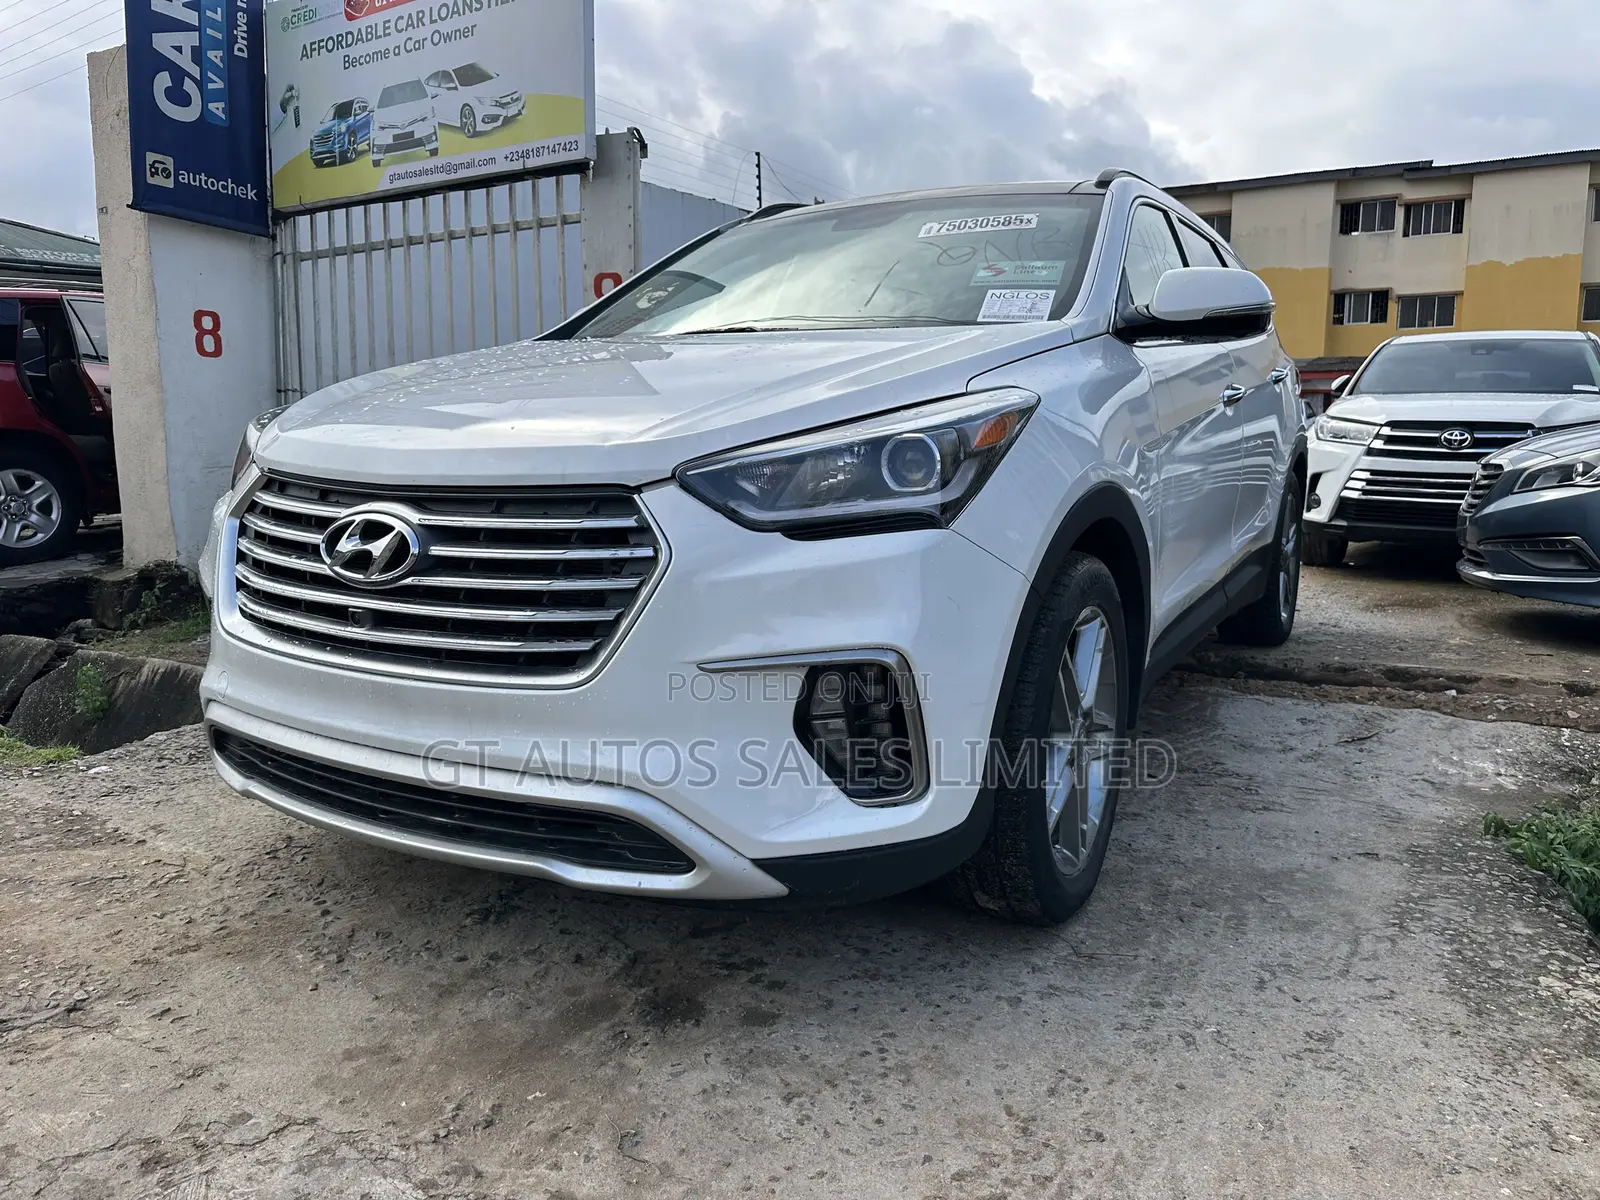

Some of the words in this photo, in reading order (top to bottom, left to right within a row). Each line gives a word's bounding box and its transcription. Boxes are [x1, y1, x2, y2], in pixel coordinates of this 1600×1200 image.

[233, 12, 247, 58] Drive
[300, 19, 391, 61] AFFORDABLE
[394, 9, 426, 34] CAR
[429, 0, 484, 25] LOANS
[343, 48, 390, 70] Become
[393, 45, 401, 57] a
[403, 36, 427, 54] Car
[430, 24, 477, 47] Owner
[388, 155, 496, 184] gtautosalesltd@gmail.com
[503, 140, 579, 162] +2348187147423
[178, 170, 258, 201] autochek
[990, 292, 1050, 300] NGLOS
[193, 309, 223, 358] 8
